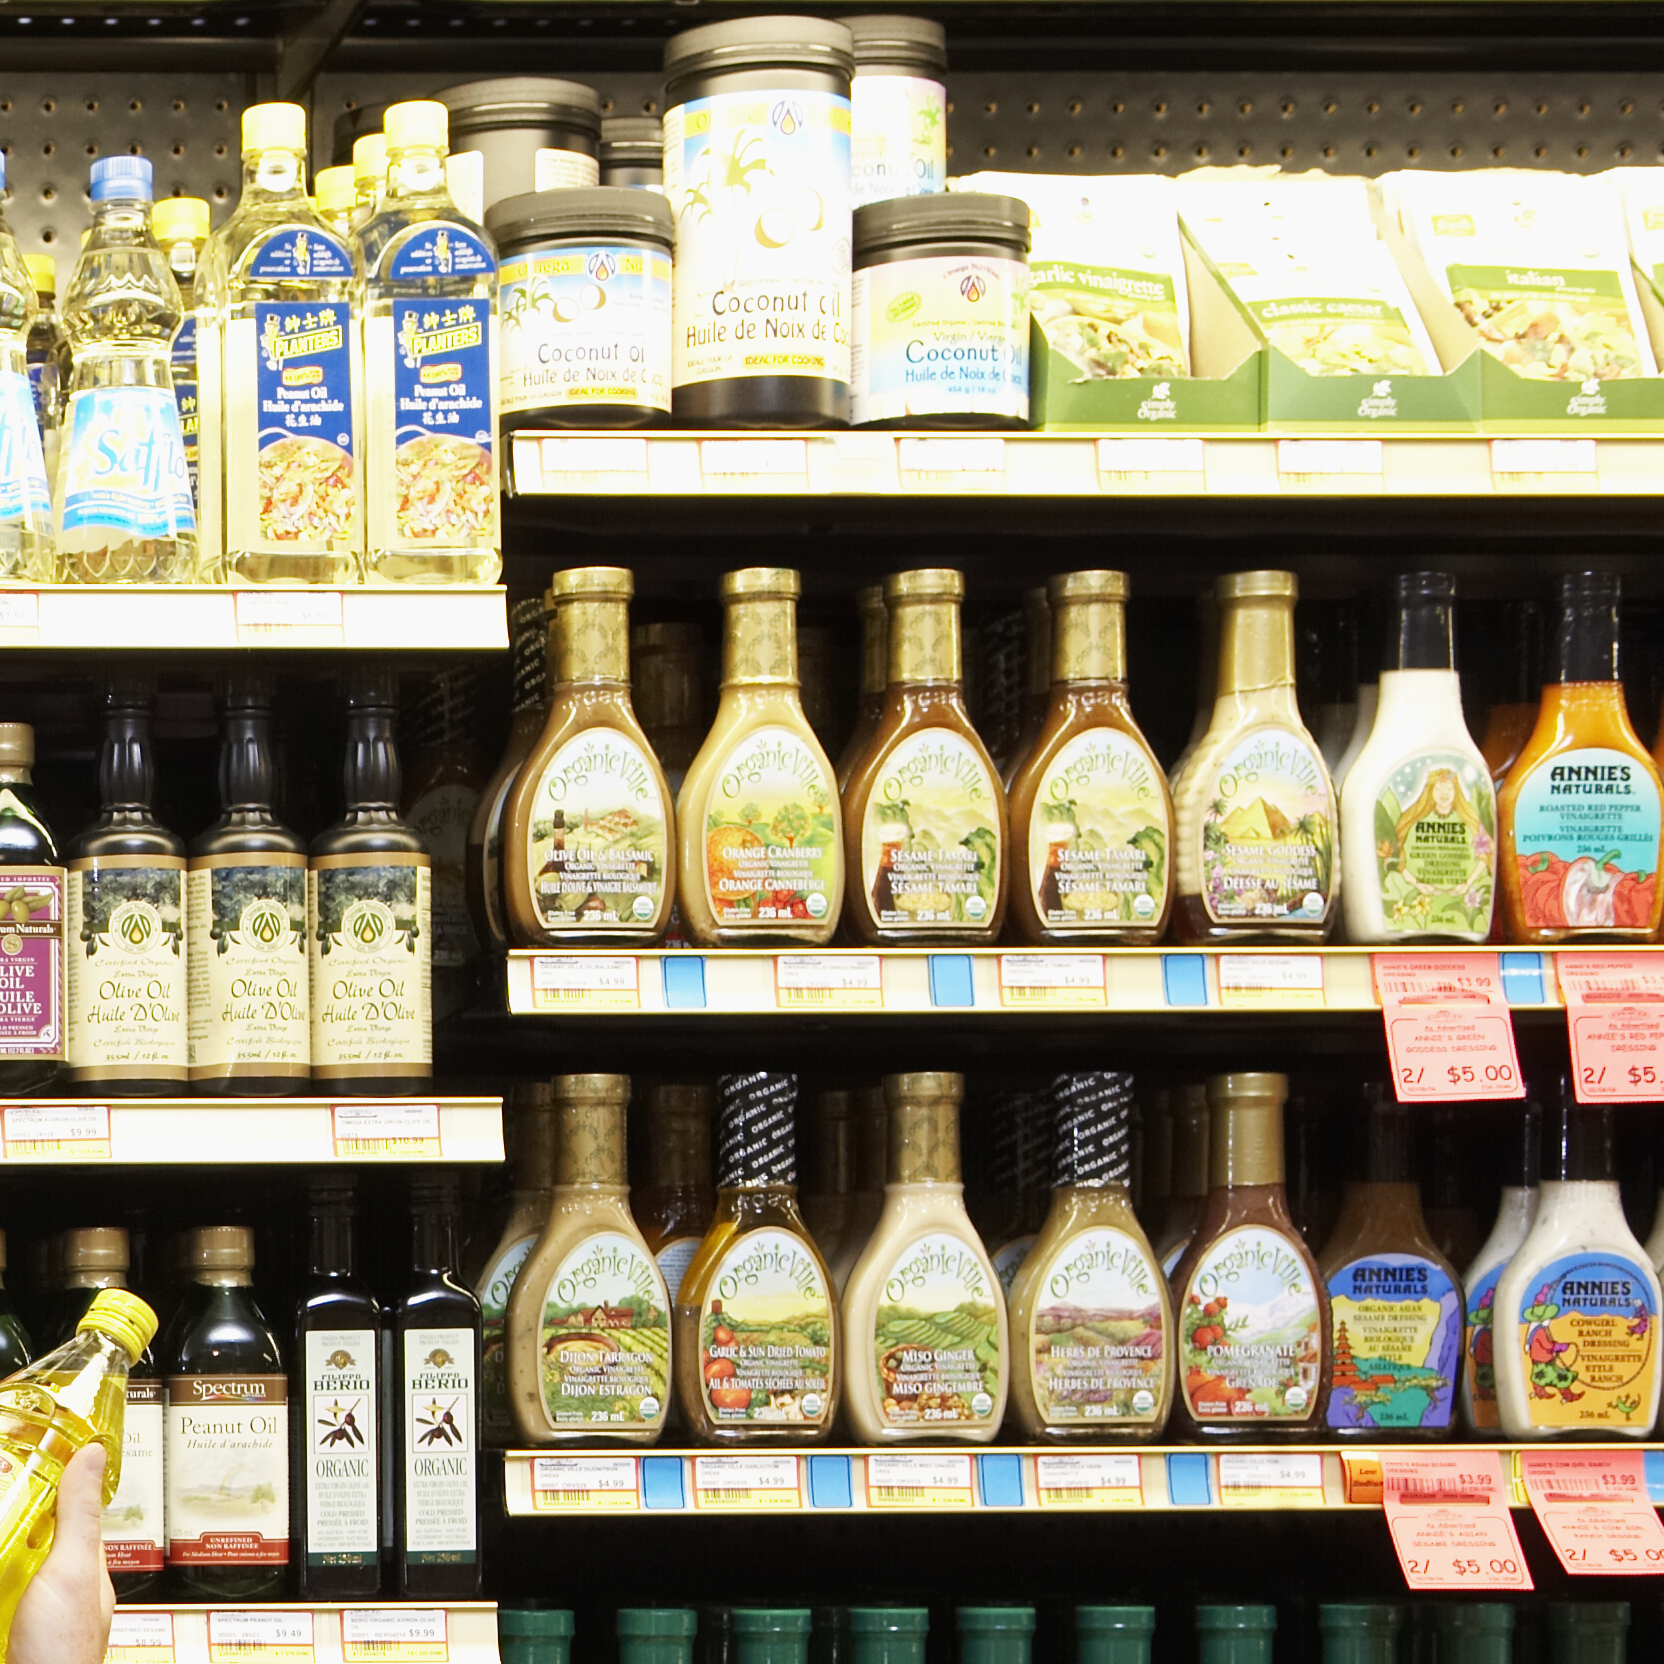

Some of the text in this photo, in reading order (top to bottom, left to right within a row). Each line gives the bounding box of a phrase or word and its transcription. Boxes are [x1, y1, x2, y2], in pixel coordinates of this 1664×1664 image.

[1077, 269, 1165, 297] vinaigrette
[1505, 270, 1565, 288] italian
[712, 291, 809, 316] Coconut
[1262, 300, 1382, 319] classic caesar
[275, 328, 341, 354] PLANTERS
[905, 341, 998, 365] Coconut
[277, 387, 328, 401] Peanut Oil
[1551, 784, 1633, 795] NATURALS
[722, 846, 823, 860] ORANGE CRANBERRY
[99, 979, 172, 1001] Olive Oil
[598, 977, 625, 986] $4.99
[1402, 1064, 1513, 1085] 2/ $5.00
[70, 1128, 97, 1137] $9.99
[560, 1350, 653, 1365] DIJON TARRAGON
[313, 1381, 370, 1390] BERIO
[180, 1416, 277, 1436] Peanut Oil
[316, 1459, 369, 1478] ORGANIC
[759, 1476, 785, 1485] $4.99
[275, 1629, 302, 1638] $9.49
